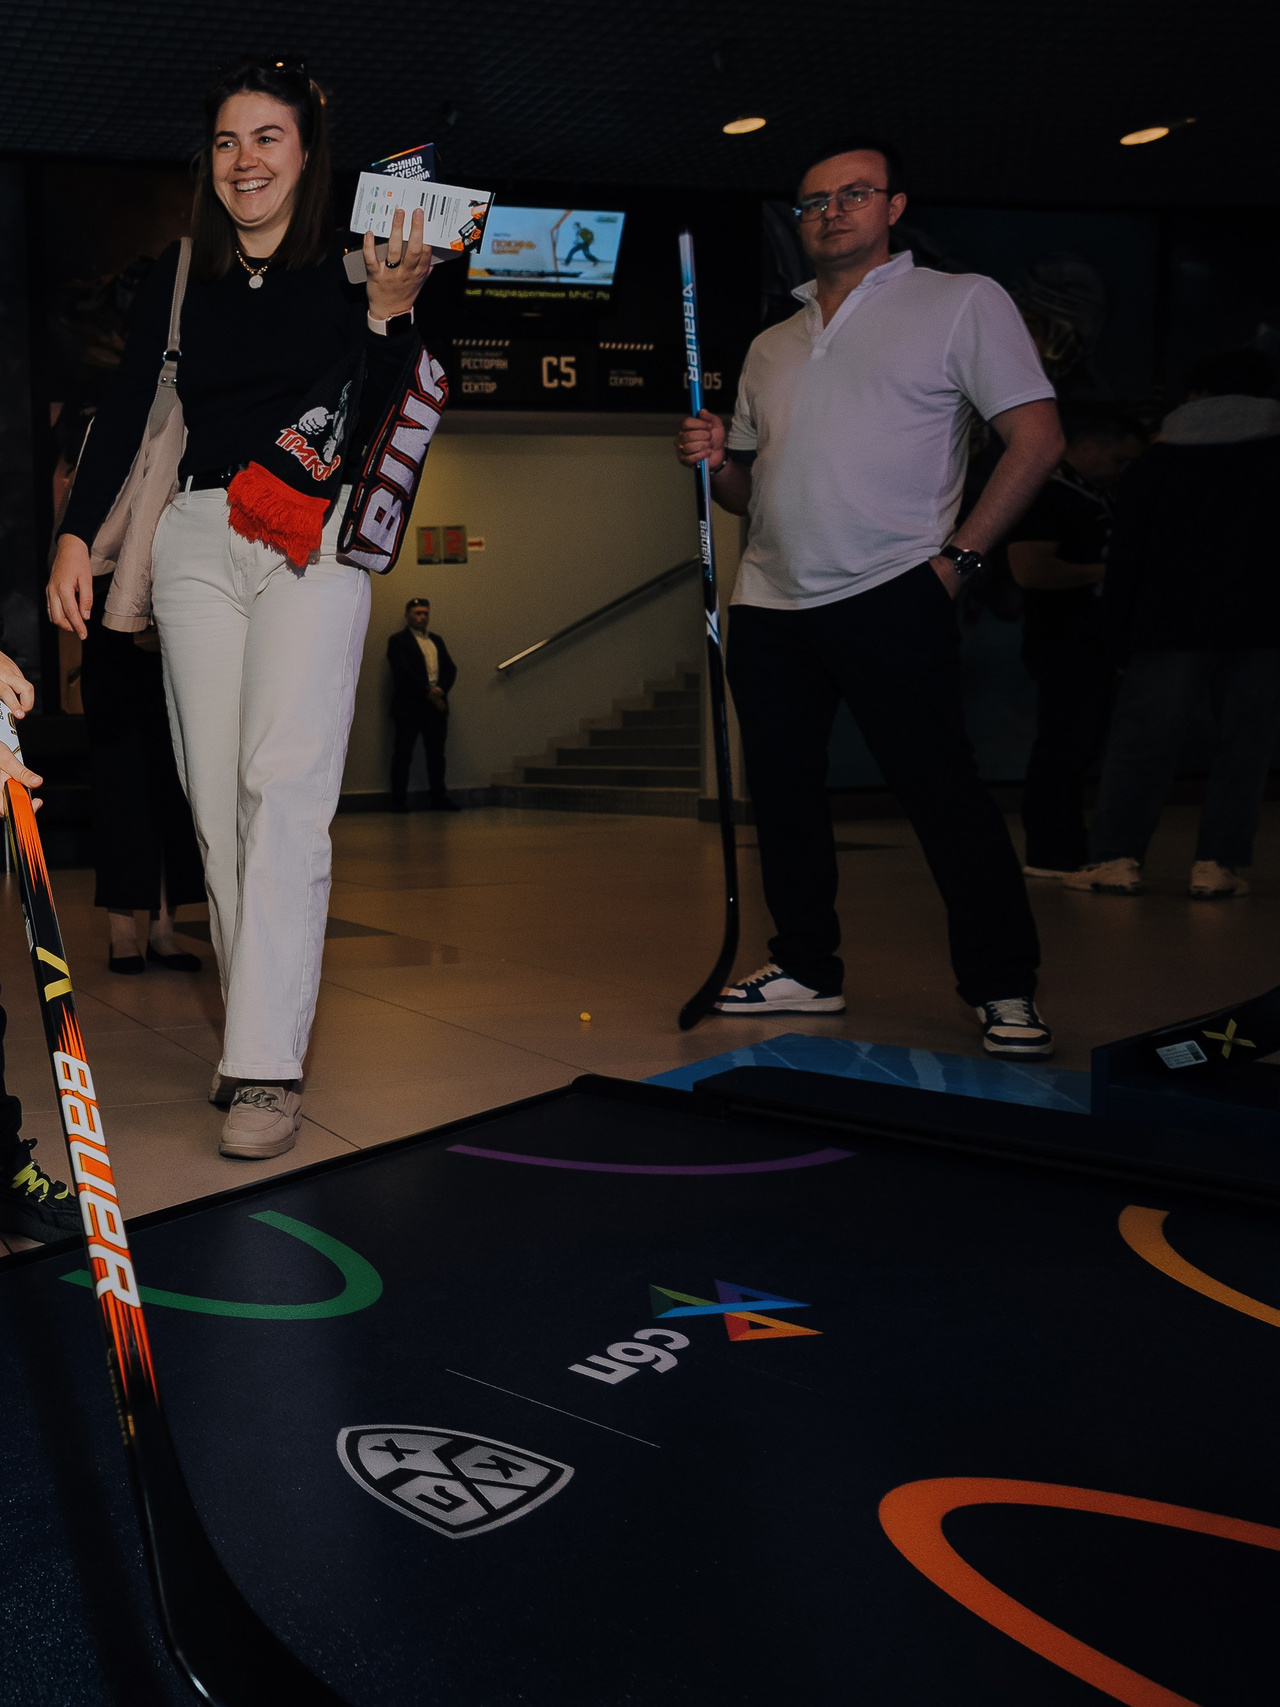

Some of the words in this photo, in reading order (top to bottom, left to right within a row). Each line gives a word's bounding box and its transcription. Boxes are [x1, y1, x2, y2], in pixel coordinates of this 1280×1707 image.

[382, 155, 423, 173] ФИНАЛ
[682, 302, 700, 383] BAUER
[461, 358, 508, 370] РЕСТОРАН
[462, 382, 497, 394] СЕКТОР
[52, 1050, 142, 1308] BAUER
